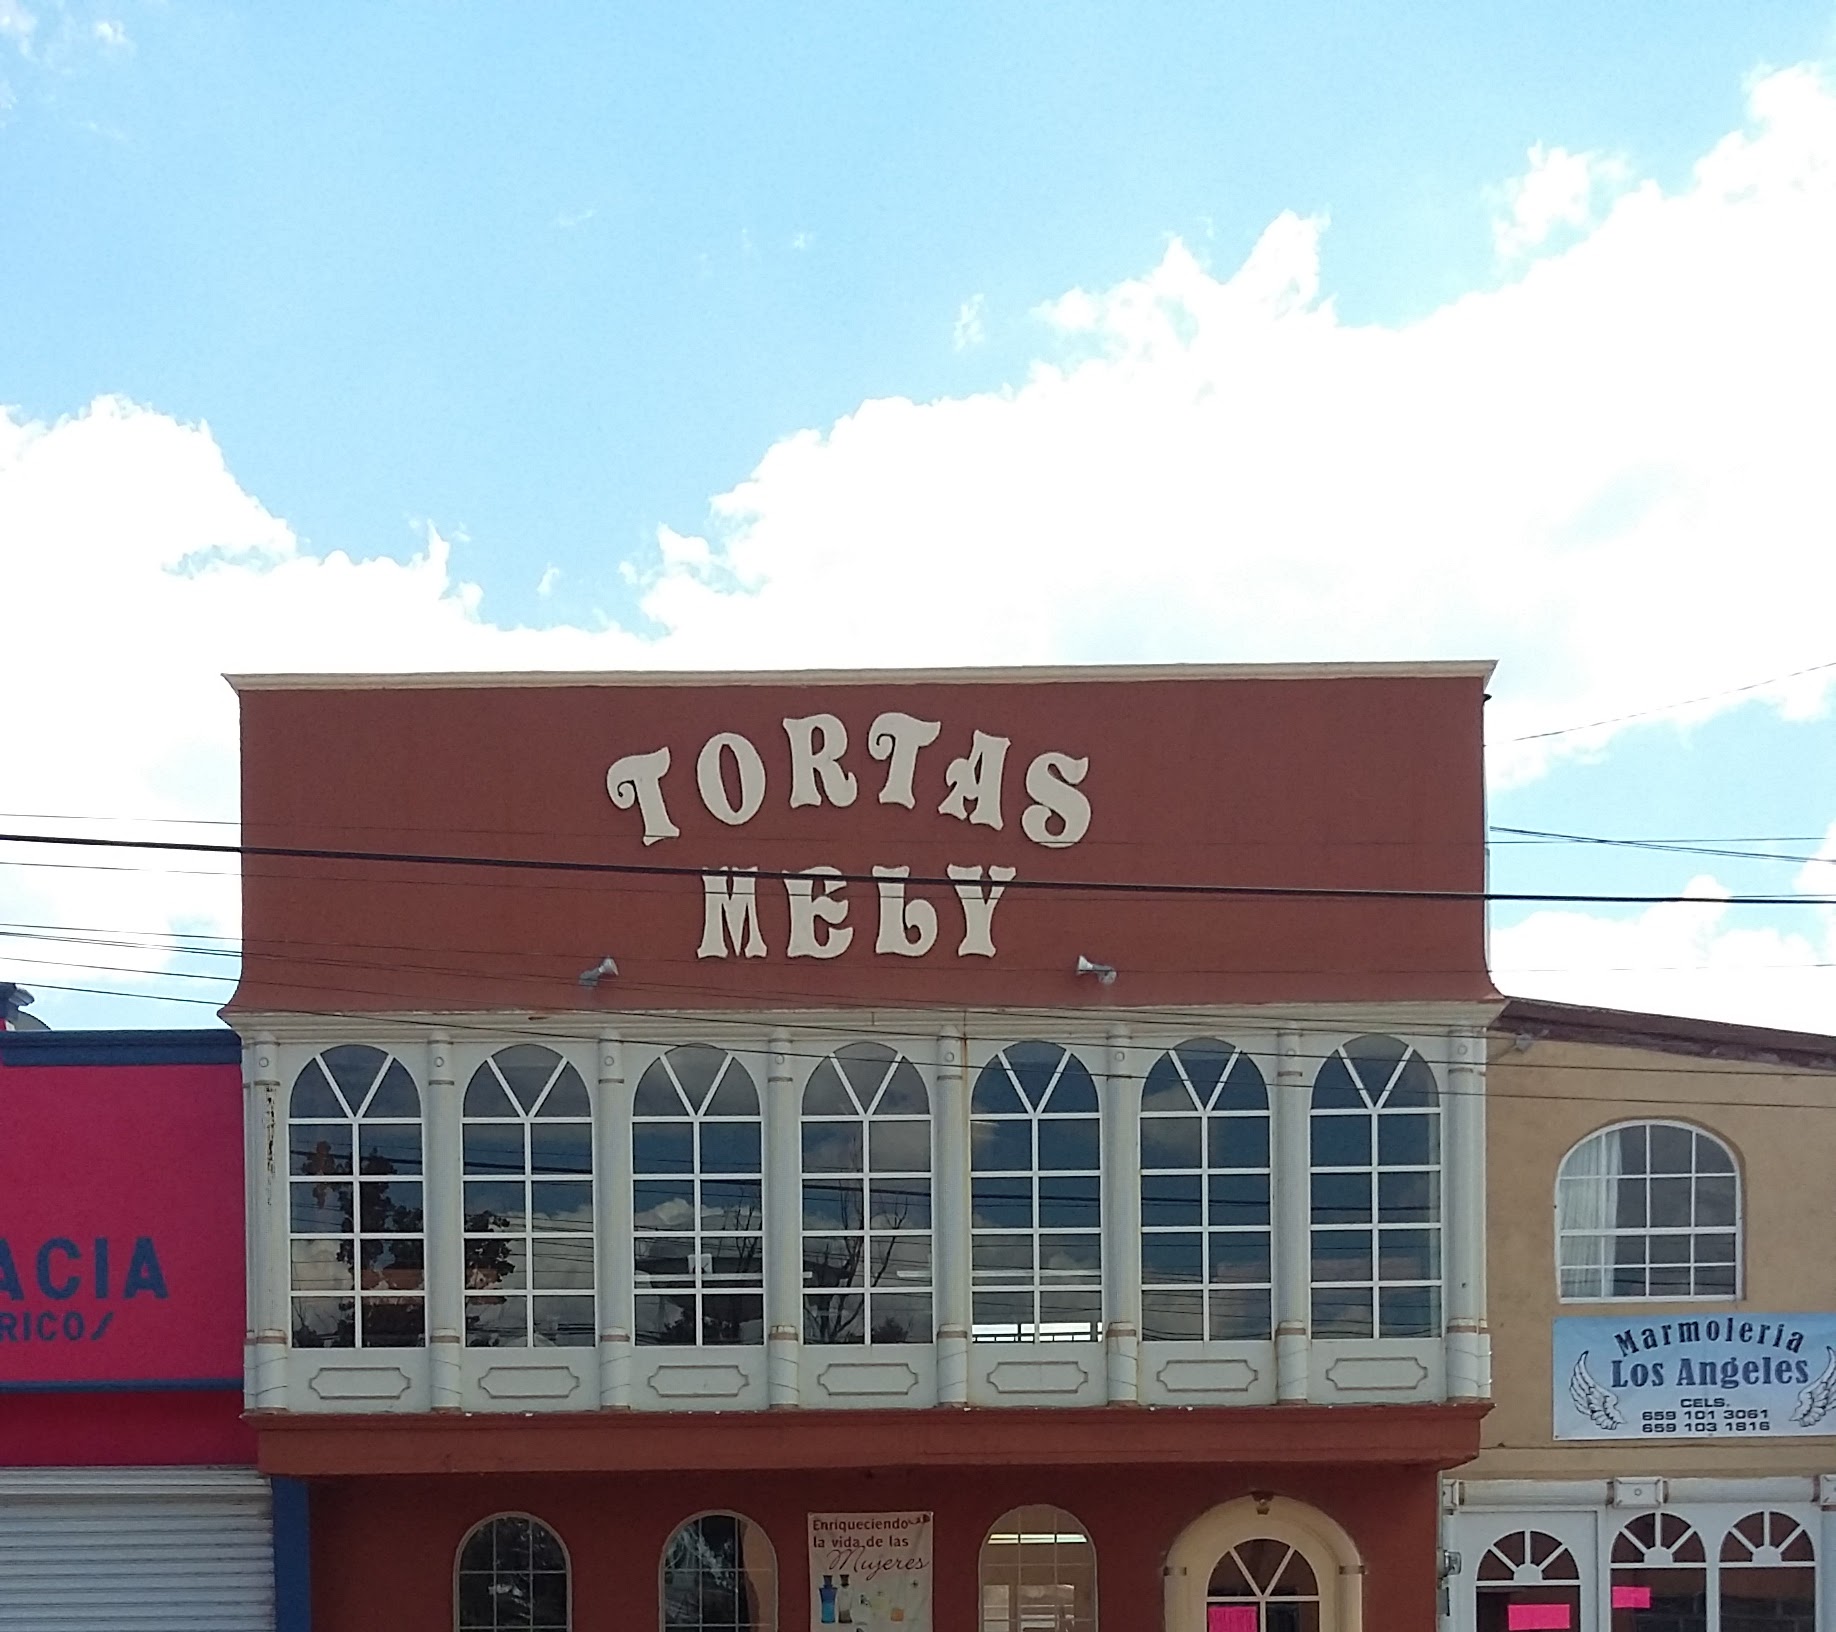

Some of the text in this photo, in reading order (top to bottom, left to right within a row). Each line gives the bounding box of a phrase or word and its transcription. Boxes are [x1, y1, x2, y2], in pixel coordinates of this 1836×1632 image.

[606, 712, 1092, 848] TORTAS
[696, 863, 1017, 960] MELY
[1611, 1356, 1809, 1389] Los Angeles
[1680, 1398, 1731, 1408] CELS.
[1642, 1409, 1769, 1421] 659 101 3061
[1642, 1423, 1676, 1433] 659
[1684, 1422, 1717, 1432] 103
[813, 1518, 909, 1533] Enriqueciendo
[813, 1536, 910, 1548] la vida de las
[827, 1548, 929, 1581] Mujeres
